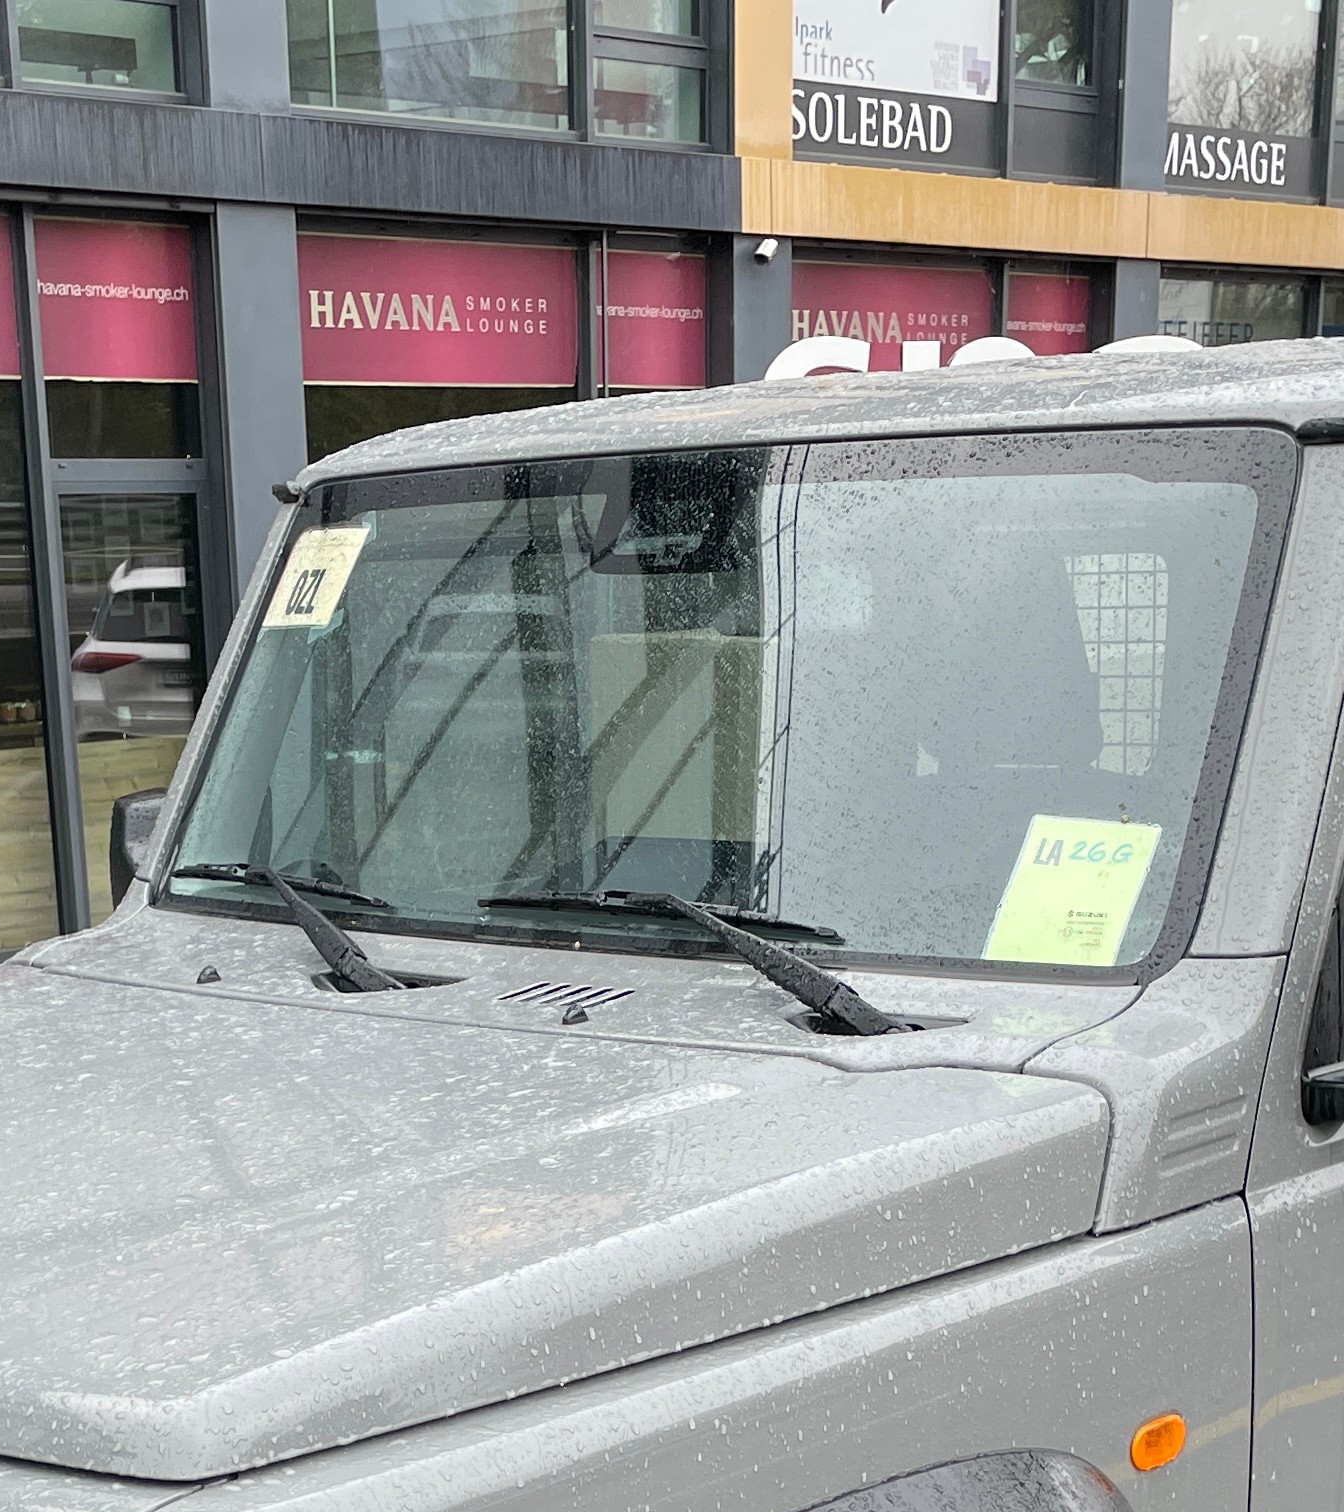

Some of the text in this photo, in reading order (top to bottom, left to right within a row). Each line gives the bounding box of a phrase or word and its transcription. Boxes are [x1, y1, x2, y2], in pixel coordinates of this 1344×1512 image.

[802, 43, 875, 82] fitness
[792, 87, 953, 153] SOLEBAD
[37, 278, 189, 304] havana-smoker-lounge.ch
[465, 295, 548, 313] SMOKER
[308, 290, 461, 332] HAVANA
[465, 317, 548, 335] LOUNGE
[907, 313, 970, 328] SMOKER
[792, 309, 903, 344] HAVANA
[1033, 837, 1065, 867] LA
